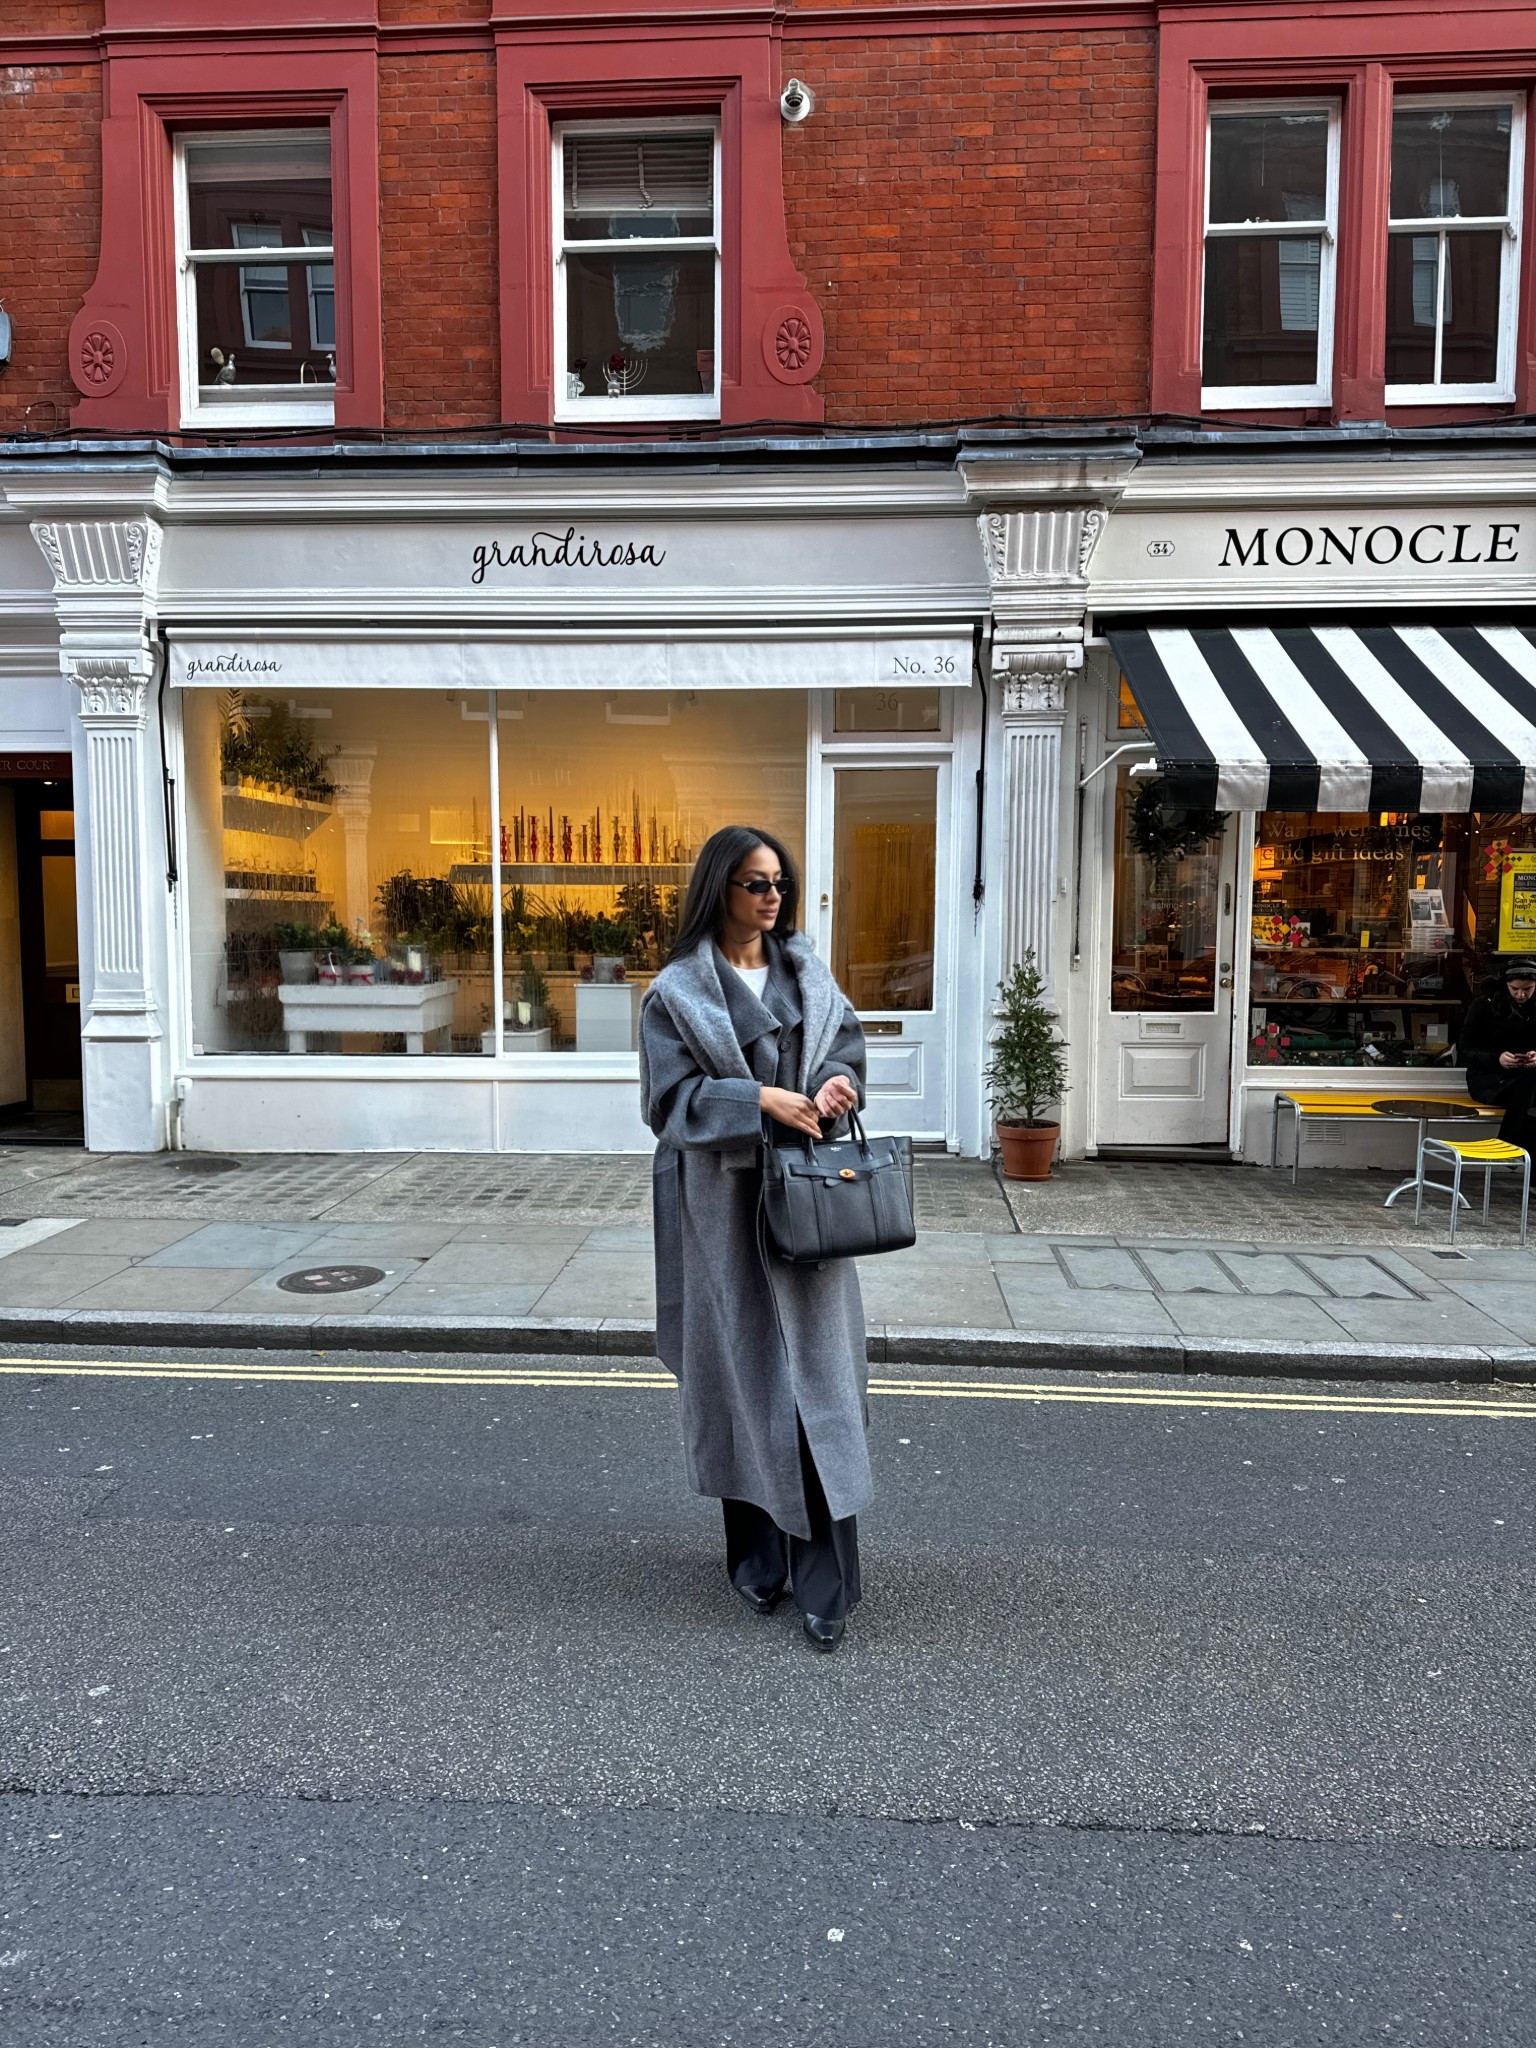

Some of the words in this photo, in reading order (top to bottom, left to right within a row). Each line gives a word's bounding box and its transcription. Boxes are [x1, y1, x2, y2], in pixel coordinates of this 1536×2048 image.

[1153, 543, 1168, 555] 34
[1218, 523, 1521, 566] MONOCLE
[471, 527, 666, 584] grandirosa
[186, 653, 282, 680] grandirosa
[893, 656, 925, 674] No.
[934, 656, 955, 674] 36
[875, 691, 899, 711] 36
[16, 760, 57, 771] COURT
[1311, 843, 1346, 864] gift
[1353, 843, 1404, 861] ideas
